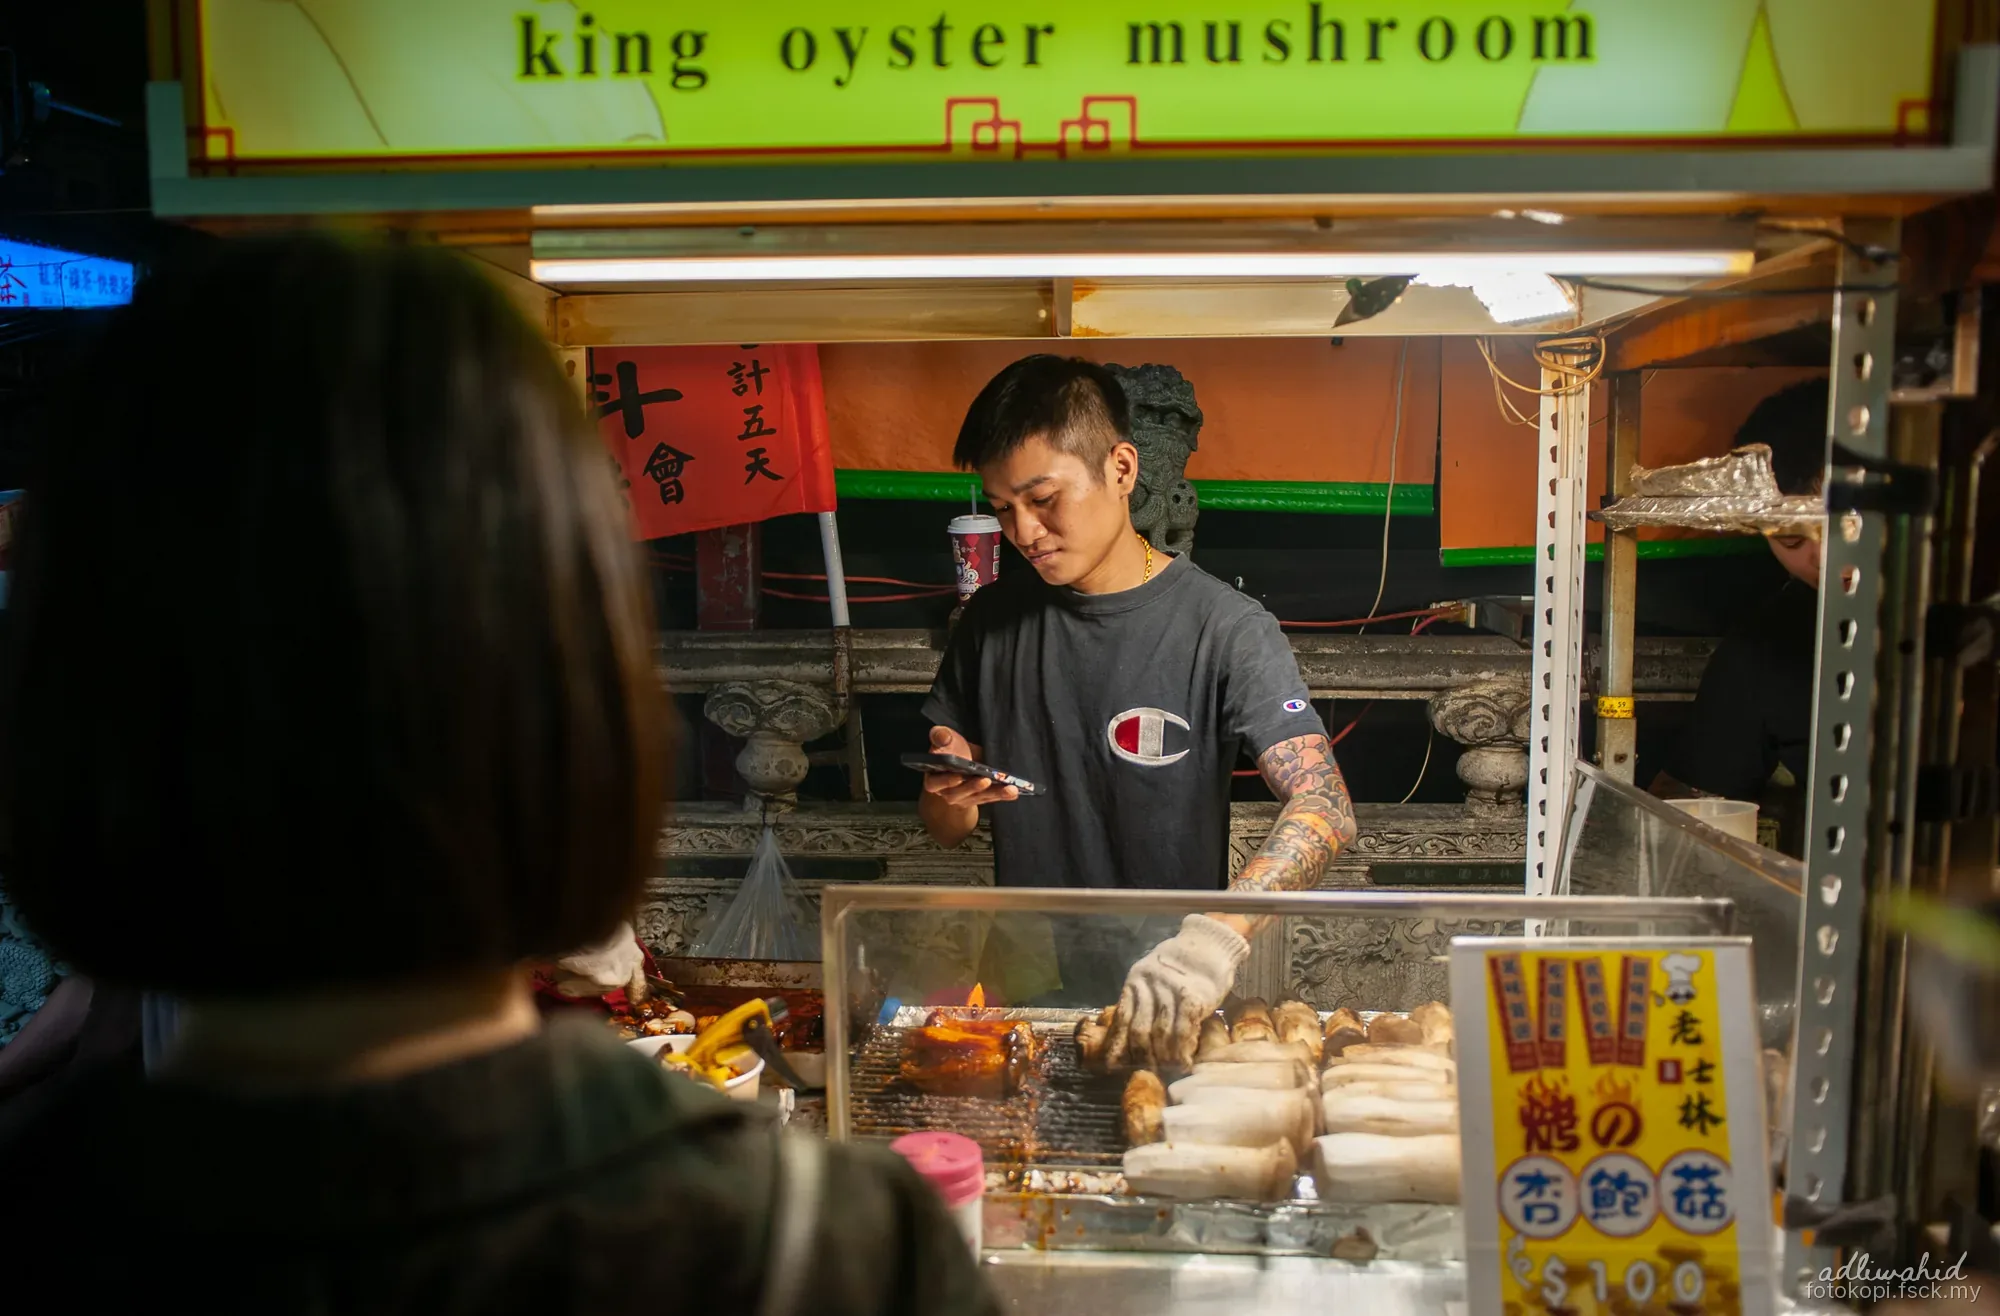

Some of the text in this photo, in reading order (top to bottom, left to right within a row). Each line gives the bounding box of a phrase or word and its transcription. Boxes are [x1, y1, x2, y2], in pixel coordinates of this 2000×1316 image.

[516, 2, 1594, 91] king oyster mushroom
[726, 343, 785, 486] 計五天
[1514, 1163, 1727, 1226] 杏鮑菇
[1540, 1253, 1706, 1308] $100
